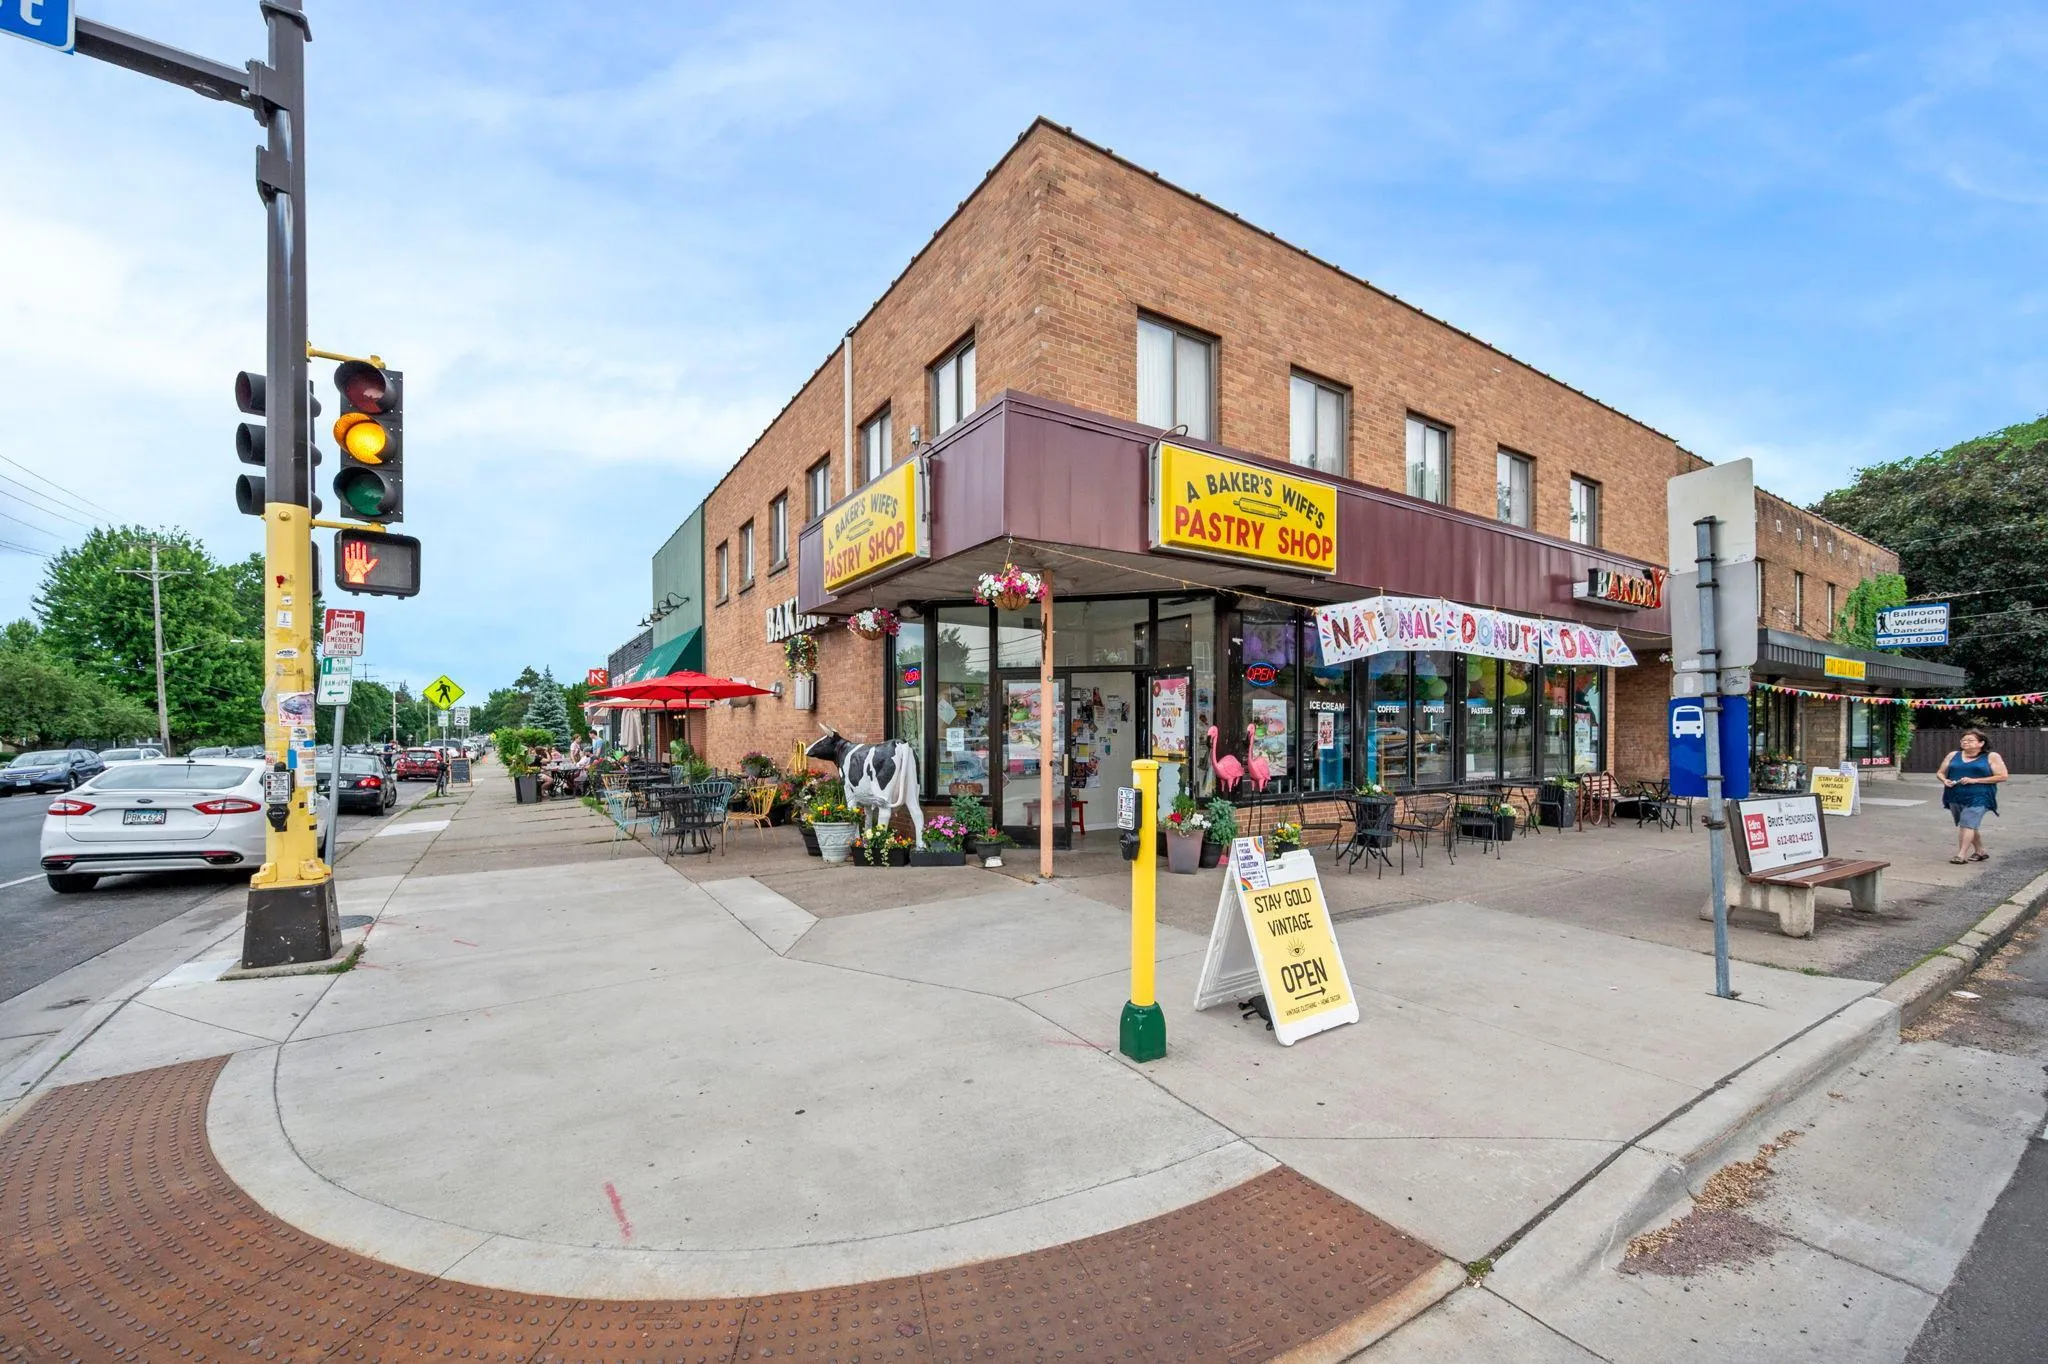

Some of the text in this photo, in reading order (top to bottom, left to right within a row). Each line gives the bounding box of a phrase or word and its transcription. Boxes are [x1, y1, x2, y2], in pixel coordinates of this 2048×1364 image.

[1186, 471, 1325, 529] A BAKER'S WIFE'S
[828, 493, 898, 555] A BAKER'S WIFE'S
[1175, 505, 1333, 561] PASTRY SHOP
[825, 521, 905, 583] PASTRY SHOP
[1588, 566, 1667, 609] BAKERY
[1893, 609, 1945, 618] Ballroom
[1895, 617, 1945, 626] Wedding
[1461, 612, 1531, 653] DONUT
[327, 635, 361, 644] EMERGENCY
[334, 643, 354, 651] ROUTE
[904, 670, 921, 682] OPEN
[1246, 667, 1276, 681] OPEN
[1309, 701, 1345, 711] ICE CREAM
[1377, 705, 1400, 713] COFFEE
[1422, 705, 1445, 713] DONUTS
[1471, 707, 1493, 715] PASTRIES
[1511, 707, 1526, 715] CAKES
[1156, 707, 1182, 717] DONUT
[455, 716, 469, 724] 25
[1161, 718, 1176, 728] DAY
[1254, 887, 1312, 914] STAY GOLD
[1280, 957, 1328, 993] OPEN
